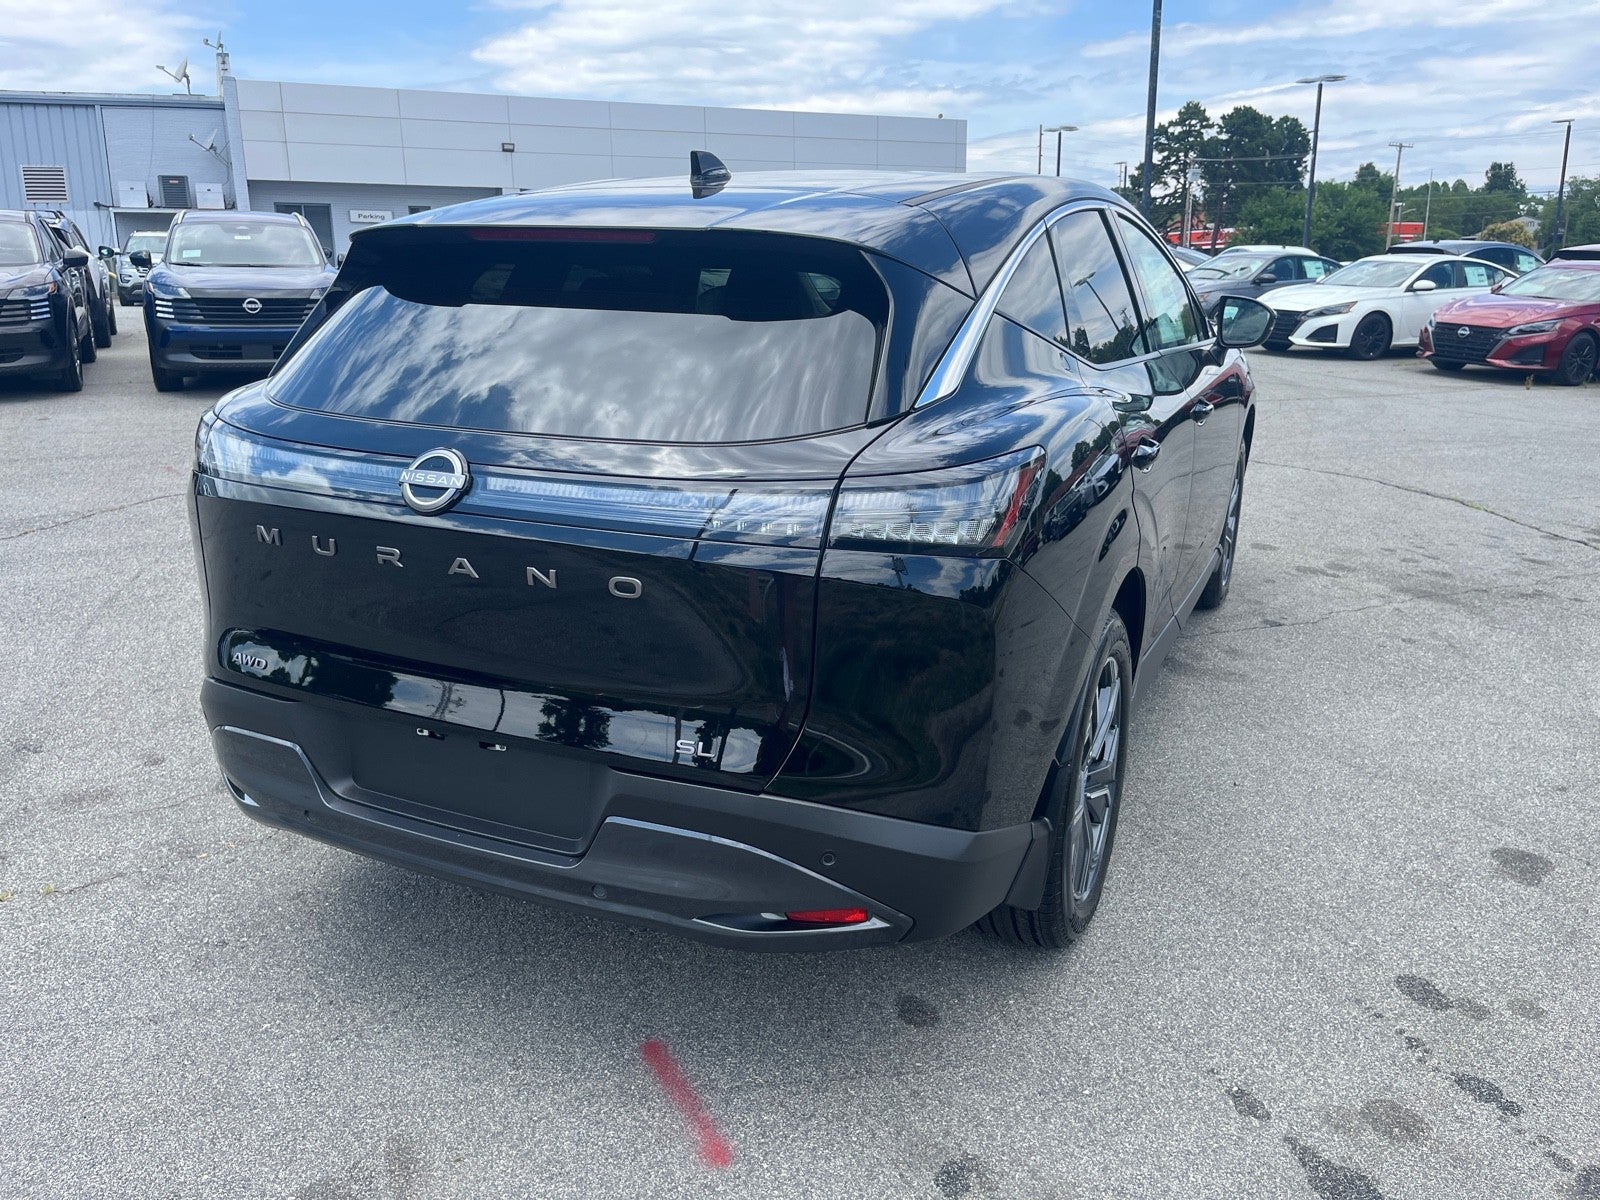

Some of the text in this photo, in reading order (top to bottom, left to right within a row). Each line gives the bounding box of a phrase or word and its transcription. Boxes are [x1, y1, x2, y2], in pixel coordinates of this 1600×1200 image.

[357, 213, 386, 221] Parking
[400, 471, 464, 488] NISSAN
[255, 524, 643, 599] MURANO
[231, 652, 268, 670] AWD
[675, 739, 716, 758] SL
